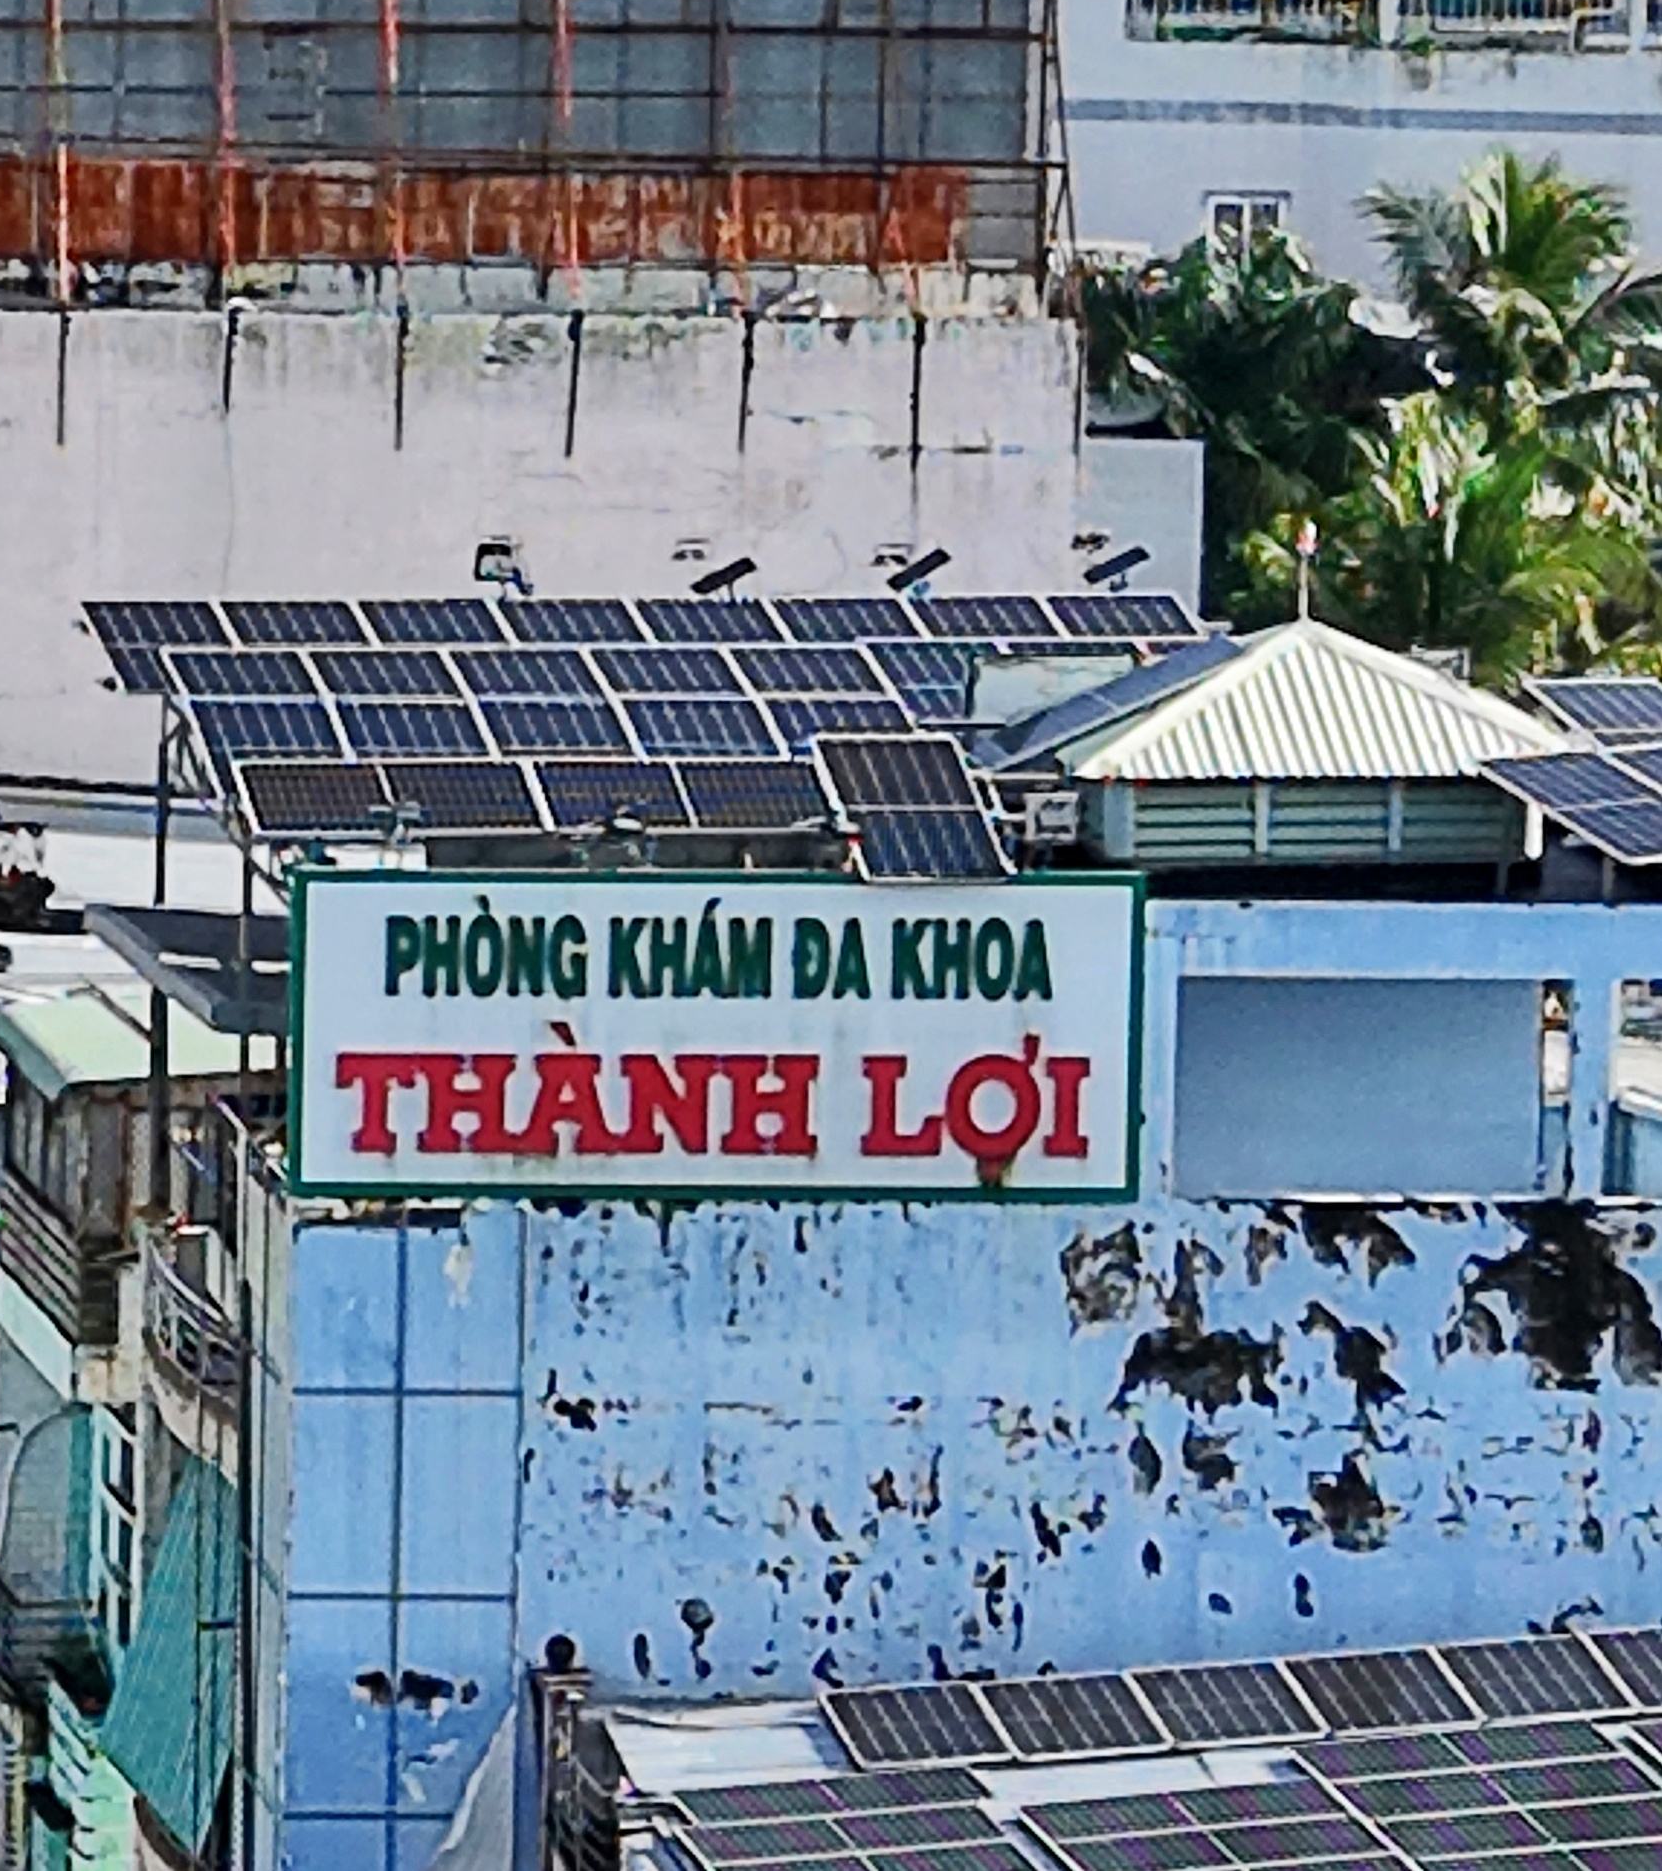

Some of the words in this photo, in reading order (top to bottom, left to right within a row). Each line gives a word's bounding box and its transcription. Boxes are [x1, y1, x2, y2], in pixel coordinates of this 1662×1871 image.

[383, 895, 588, 1000] PHÒNG
[608, 898, 772, 1000] KHÁM
[792, 917, 870, 1001] ĐA
[891, 917, 1052, 1002] KHOA
[335, 1021, 818, 1157] THÀNH
[859, 1034, 1092, 1187] LỢI
